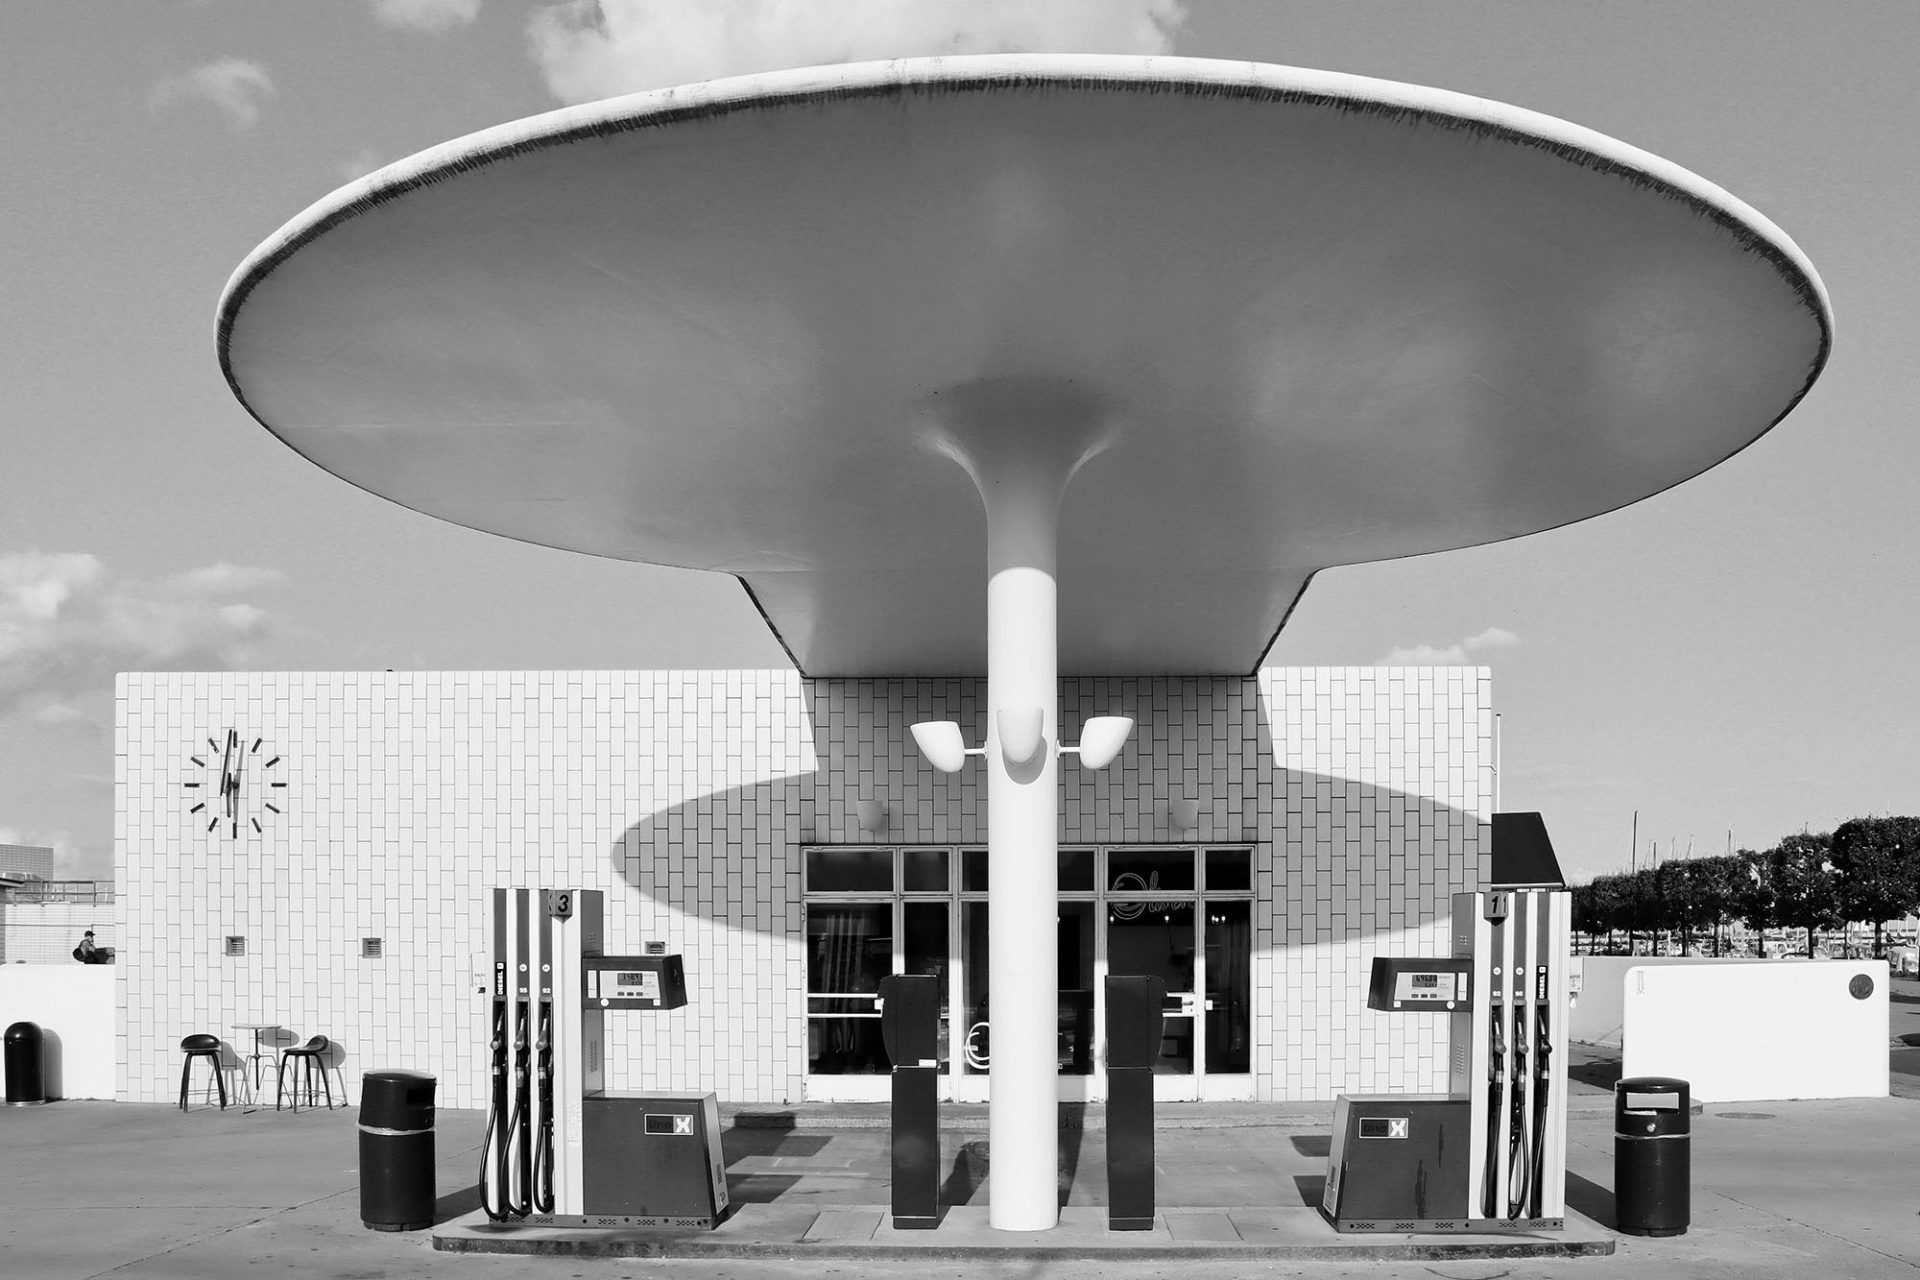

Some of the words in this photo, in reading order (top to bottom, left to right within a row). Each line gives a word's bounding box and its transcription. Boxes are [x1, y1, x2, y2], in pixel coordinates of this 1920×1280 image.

[557, 894, 569, 913] 3
[1491, 895, 1499, 914] 1
[675, 1116, 691, 1133] X
[1389, 1120, 1406, 1137] X
